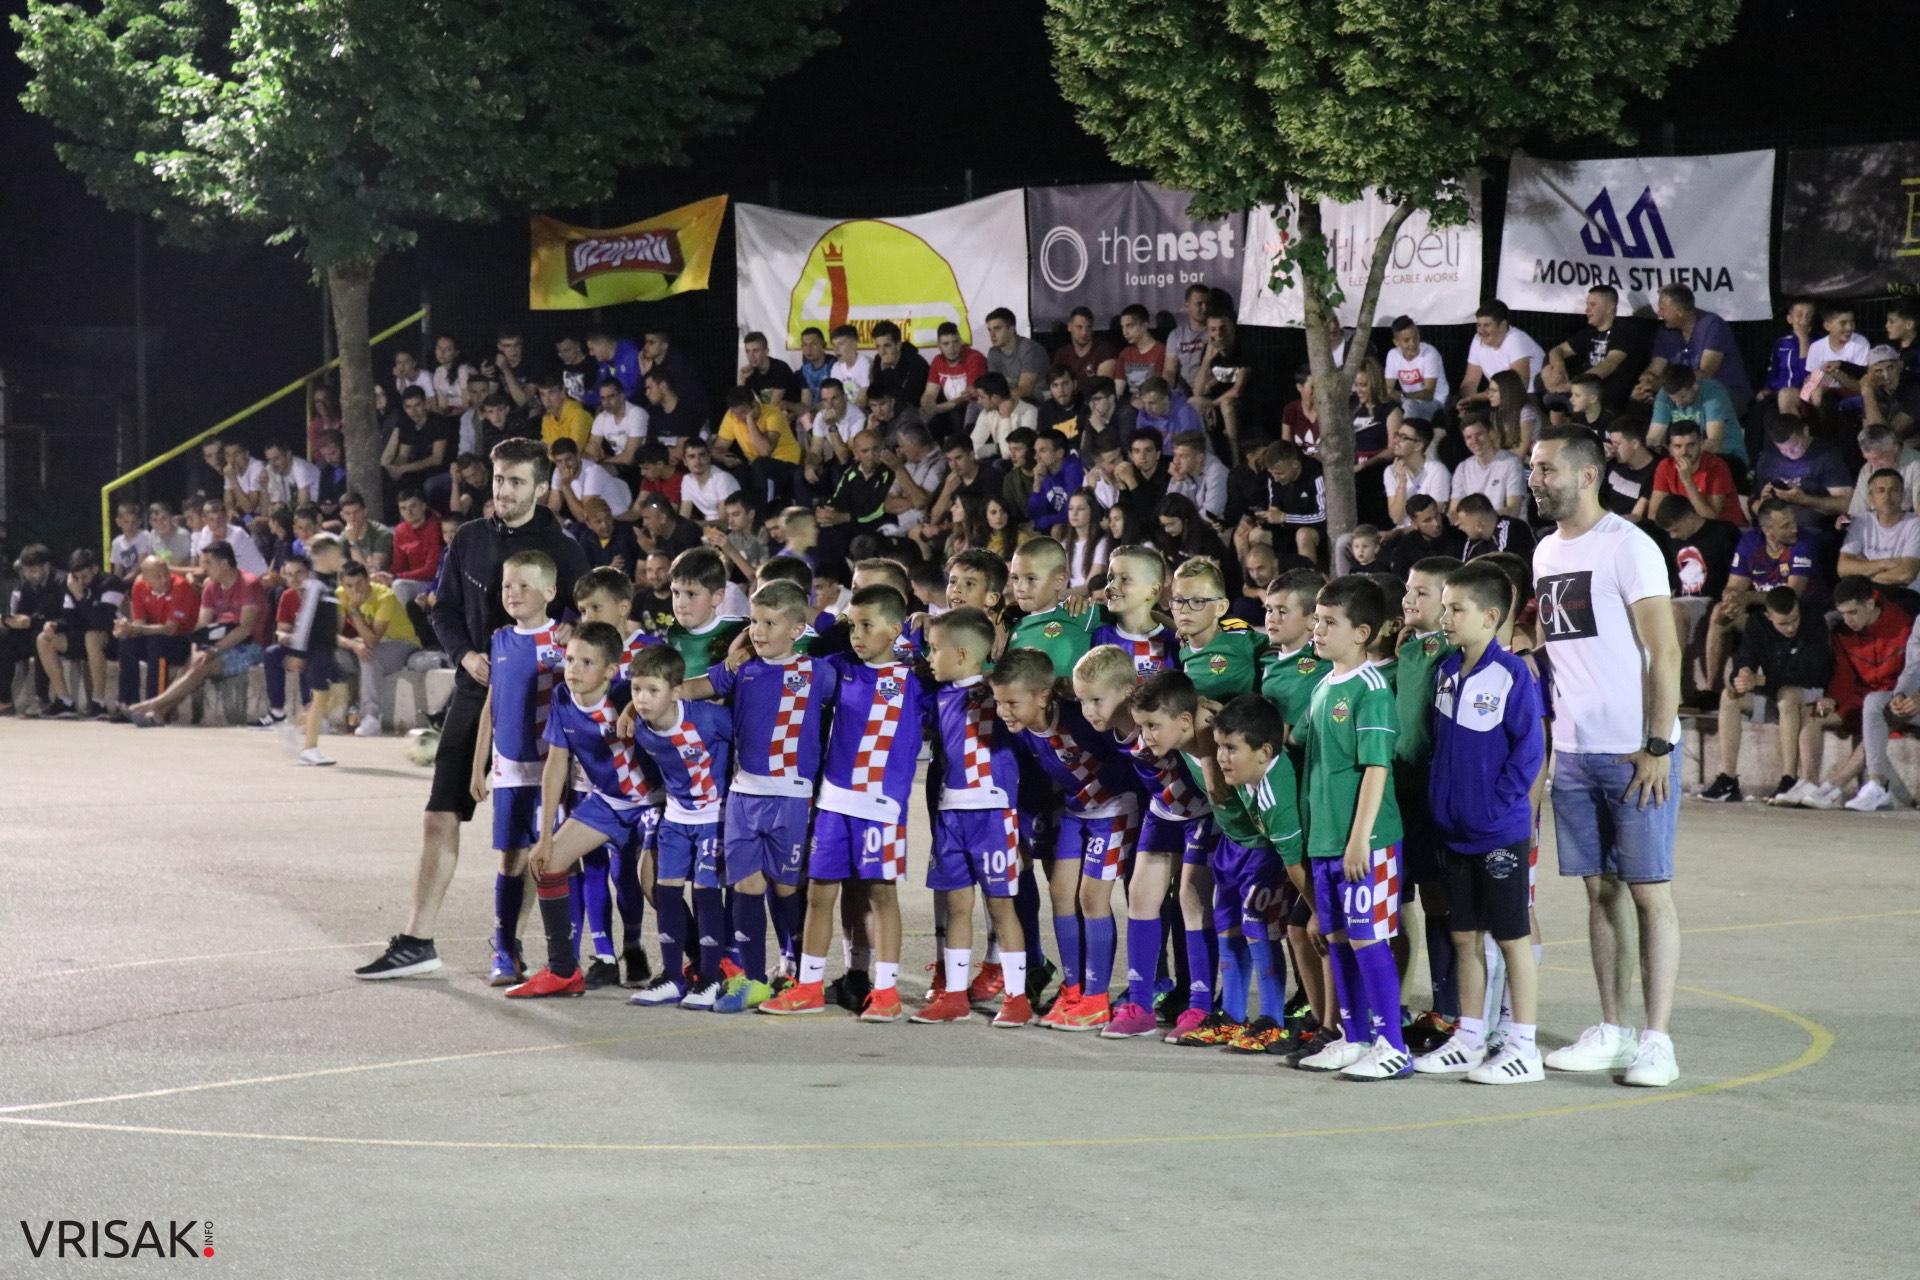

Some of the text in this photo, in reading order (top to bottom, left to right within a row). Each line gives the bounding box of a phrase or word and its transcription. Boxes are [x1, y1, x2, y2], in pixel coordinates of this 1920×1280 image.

[1098, 222, 1235, 265] the nest
[1125, 269, 1206, 288] lounge bar
[1532, 258, 1623, 292] MODRA
[791, 843, 801, 865] 5
[1086, 836, 1105, 855] 28
[982, 850, 1007, 875] 10
[1343, 885, 1372, 914] 10
